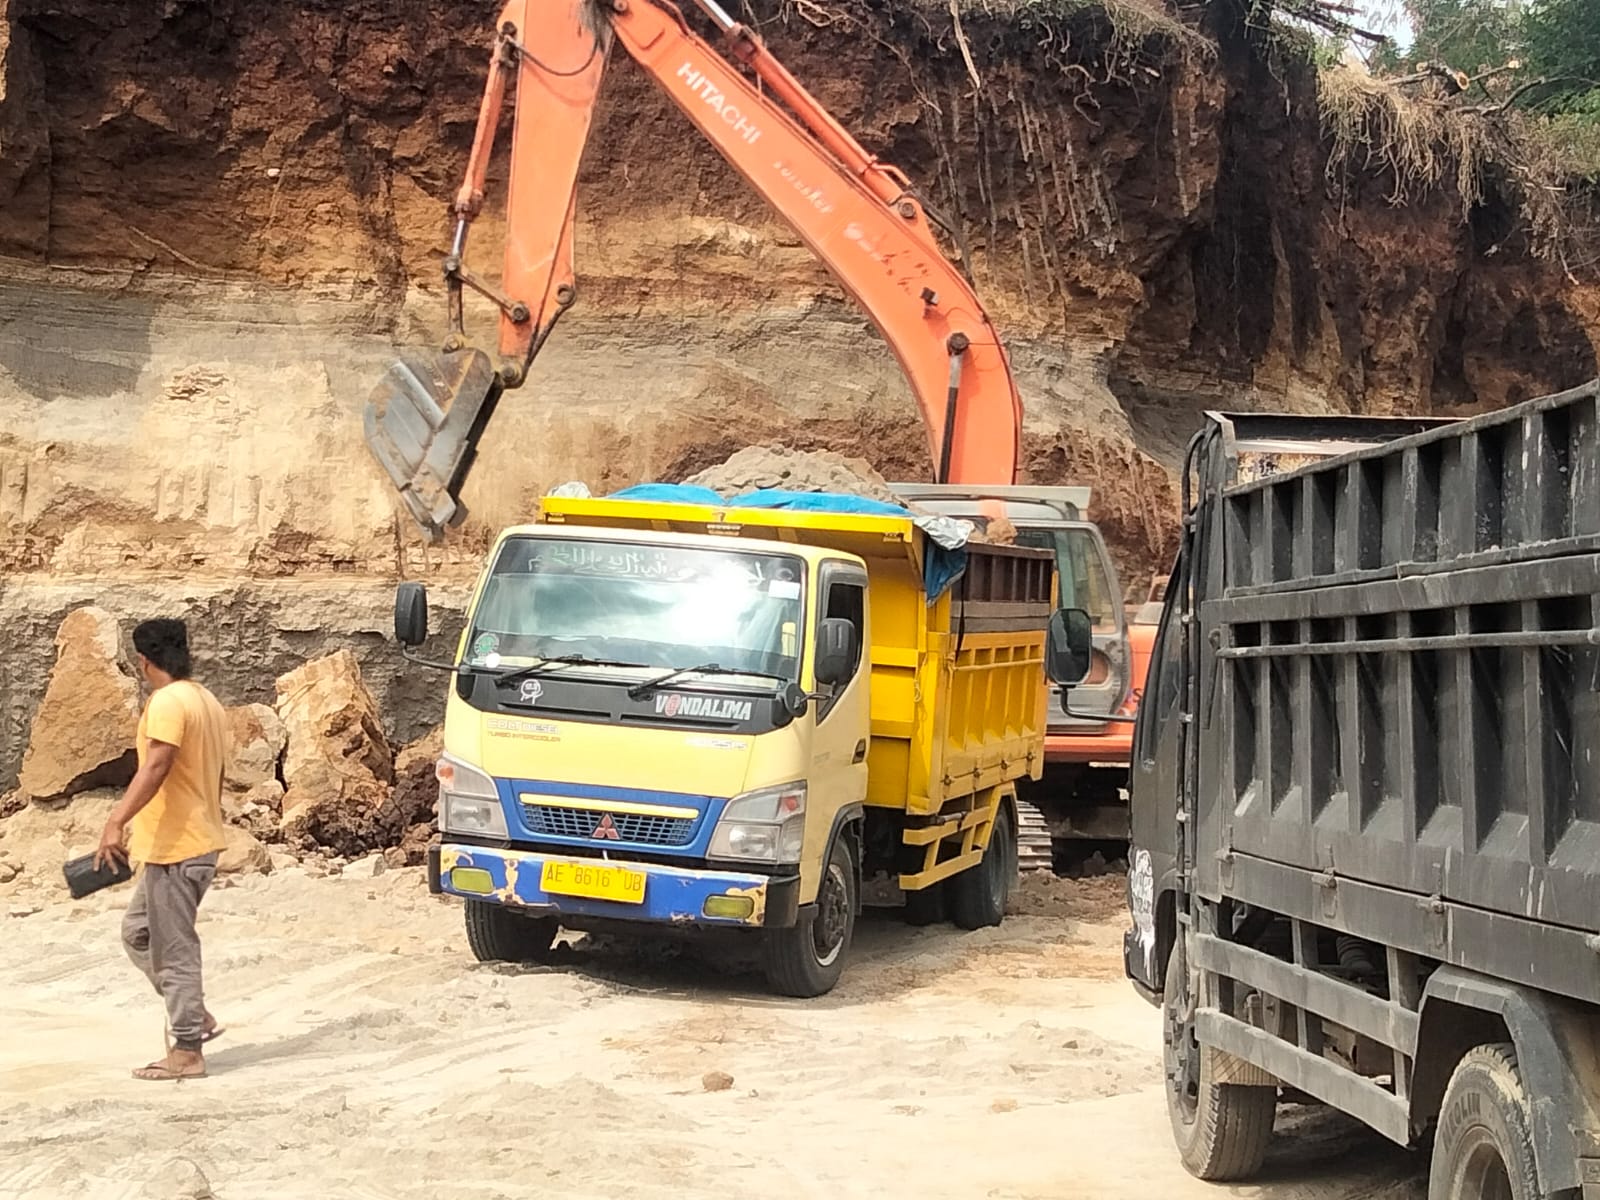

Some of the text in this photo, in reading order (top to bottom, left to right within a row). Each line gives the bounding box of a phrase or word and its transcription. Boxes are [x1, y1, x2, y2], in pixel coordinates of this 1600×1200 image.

[676, 61, 763, 144] HITACHI
[545, 863, 642, 892] AE 8616 UB
